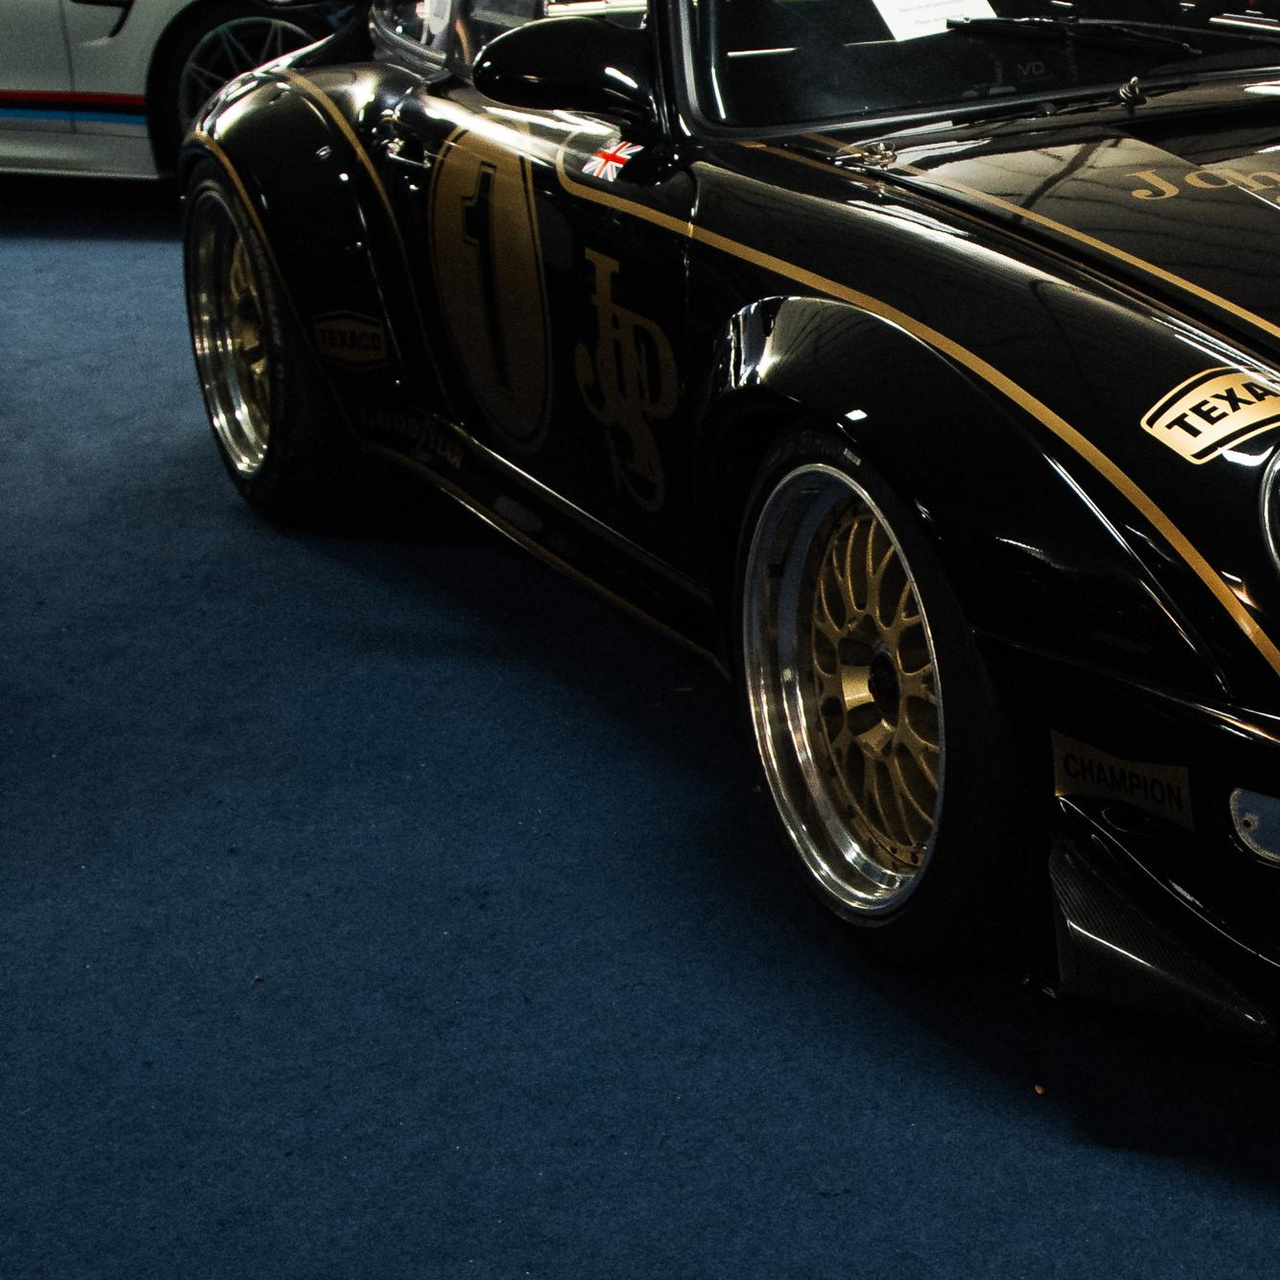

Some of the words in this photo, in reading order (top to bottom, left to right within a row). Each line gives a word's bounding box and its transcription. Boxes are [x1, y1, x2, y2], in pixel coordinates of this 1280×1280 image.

[461, 160, 516, 402] 1
[318, 328, 382, 351] TEXACO
[1064, 753, 1183, 810] CHAMPION
